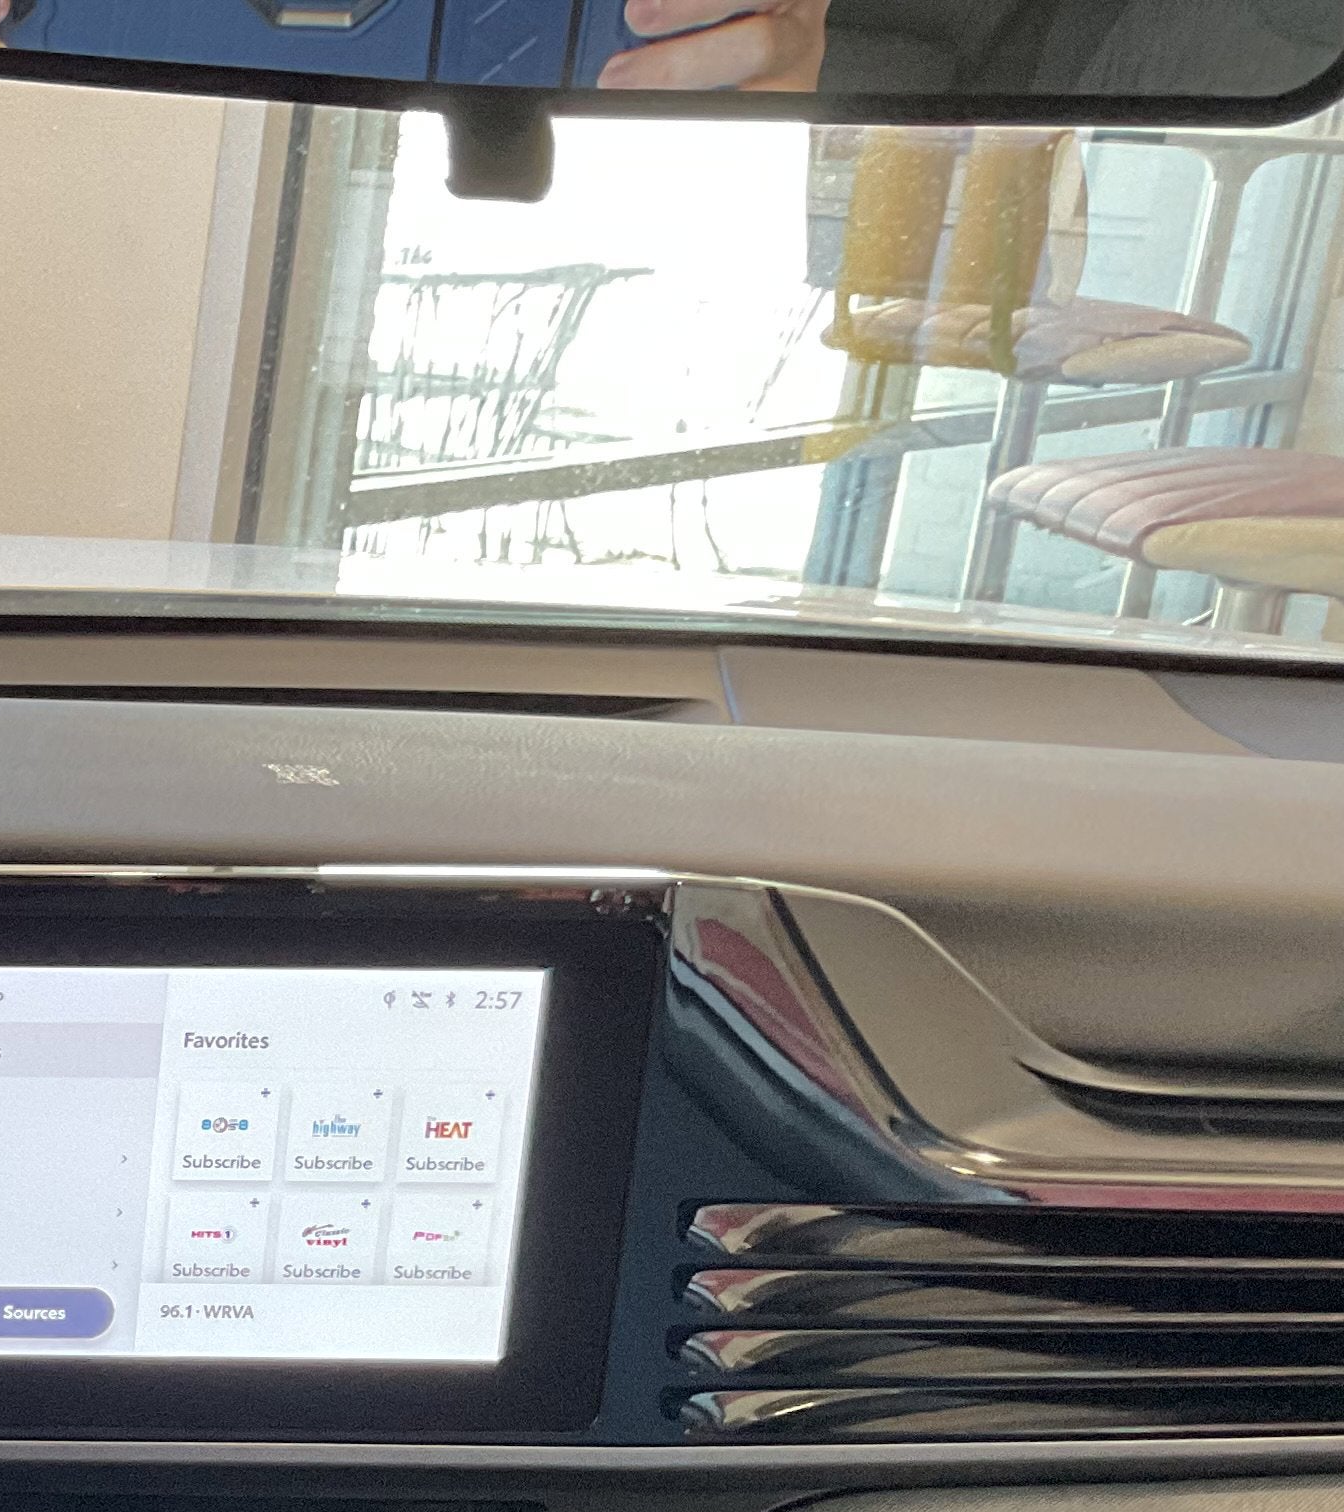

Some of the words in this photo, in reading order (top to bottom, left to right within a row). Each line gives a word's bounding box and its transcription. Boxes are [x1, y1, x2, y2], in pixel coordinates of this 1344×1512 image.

[474, 990, 523, 1009] 2:57
[183, 1031, 270, 1049] Favorites
[424, 1122, 473, 1139] HEAT
[182, 1155, 261, 1170] Subscribe
[294, 1156, 373, 1171] Subscribe
[406, 1157, 485, 1172] Subscribe
[191, 1230, 222, 1239] HITS
[306, 1237, 348, 1248] vinyl
[172, 1263, 250, 1279] Subscribe
[282, 1264, 361, 1280] Subscribe
[393, 1265, 472, 1281] Subscribe
[2, 1305, 66, 1320] Sources
[203, 1305, 255, 1320] WRVA
